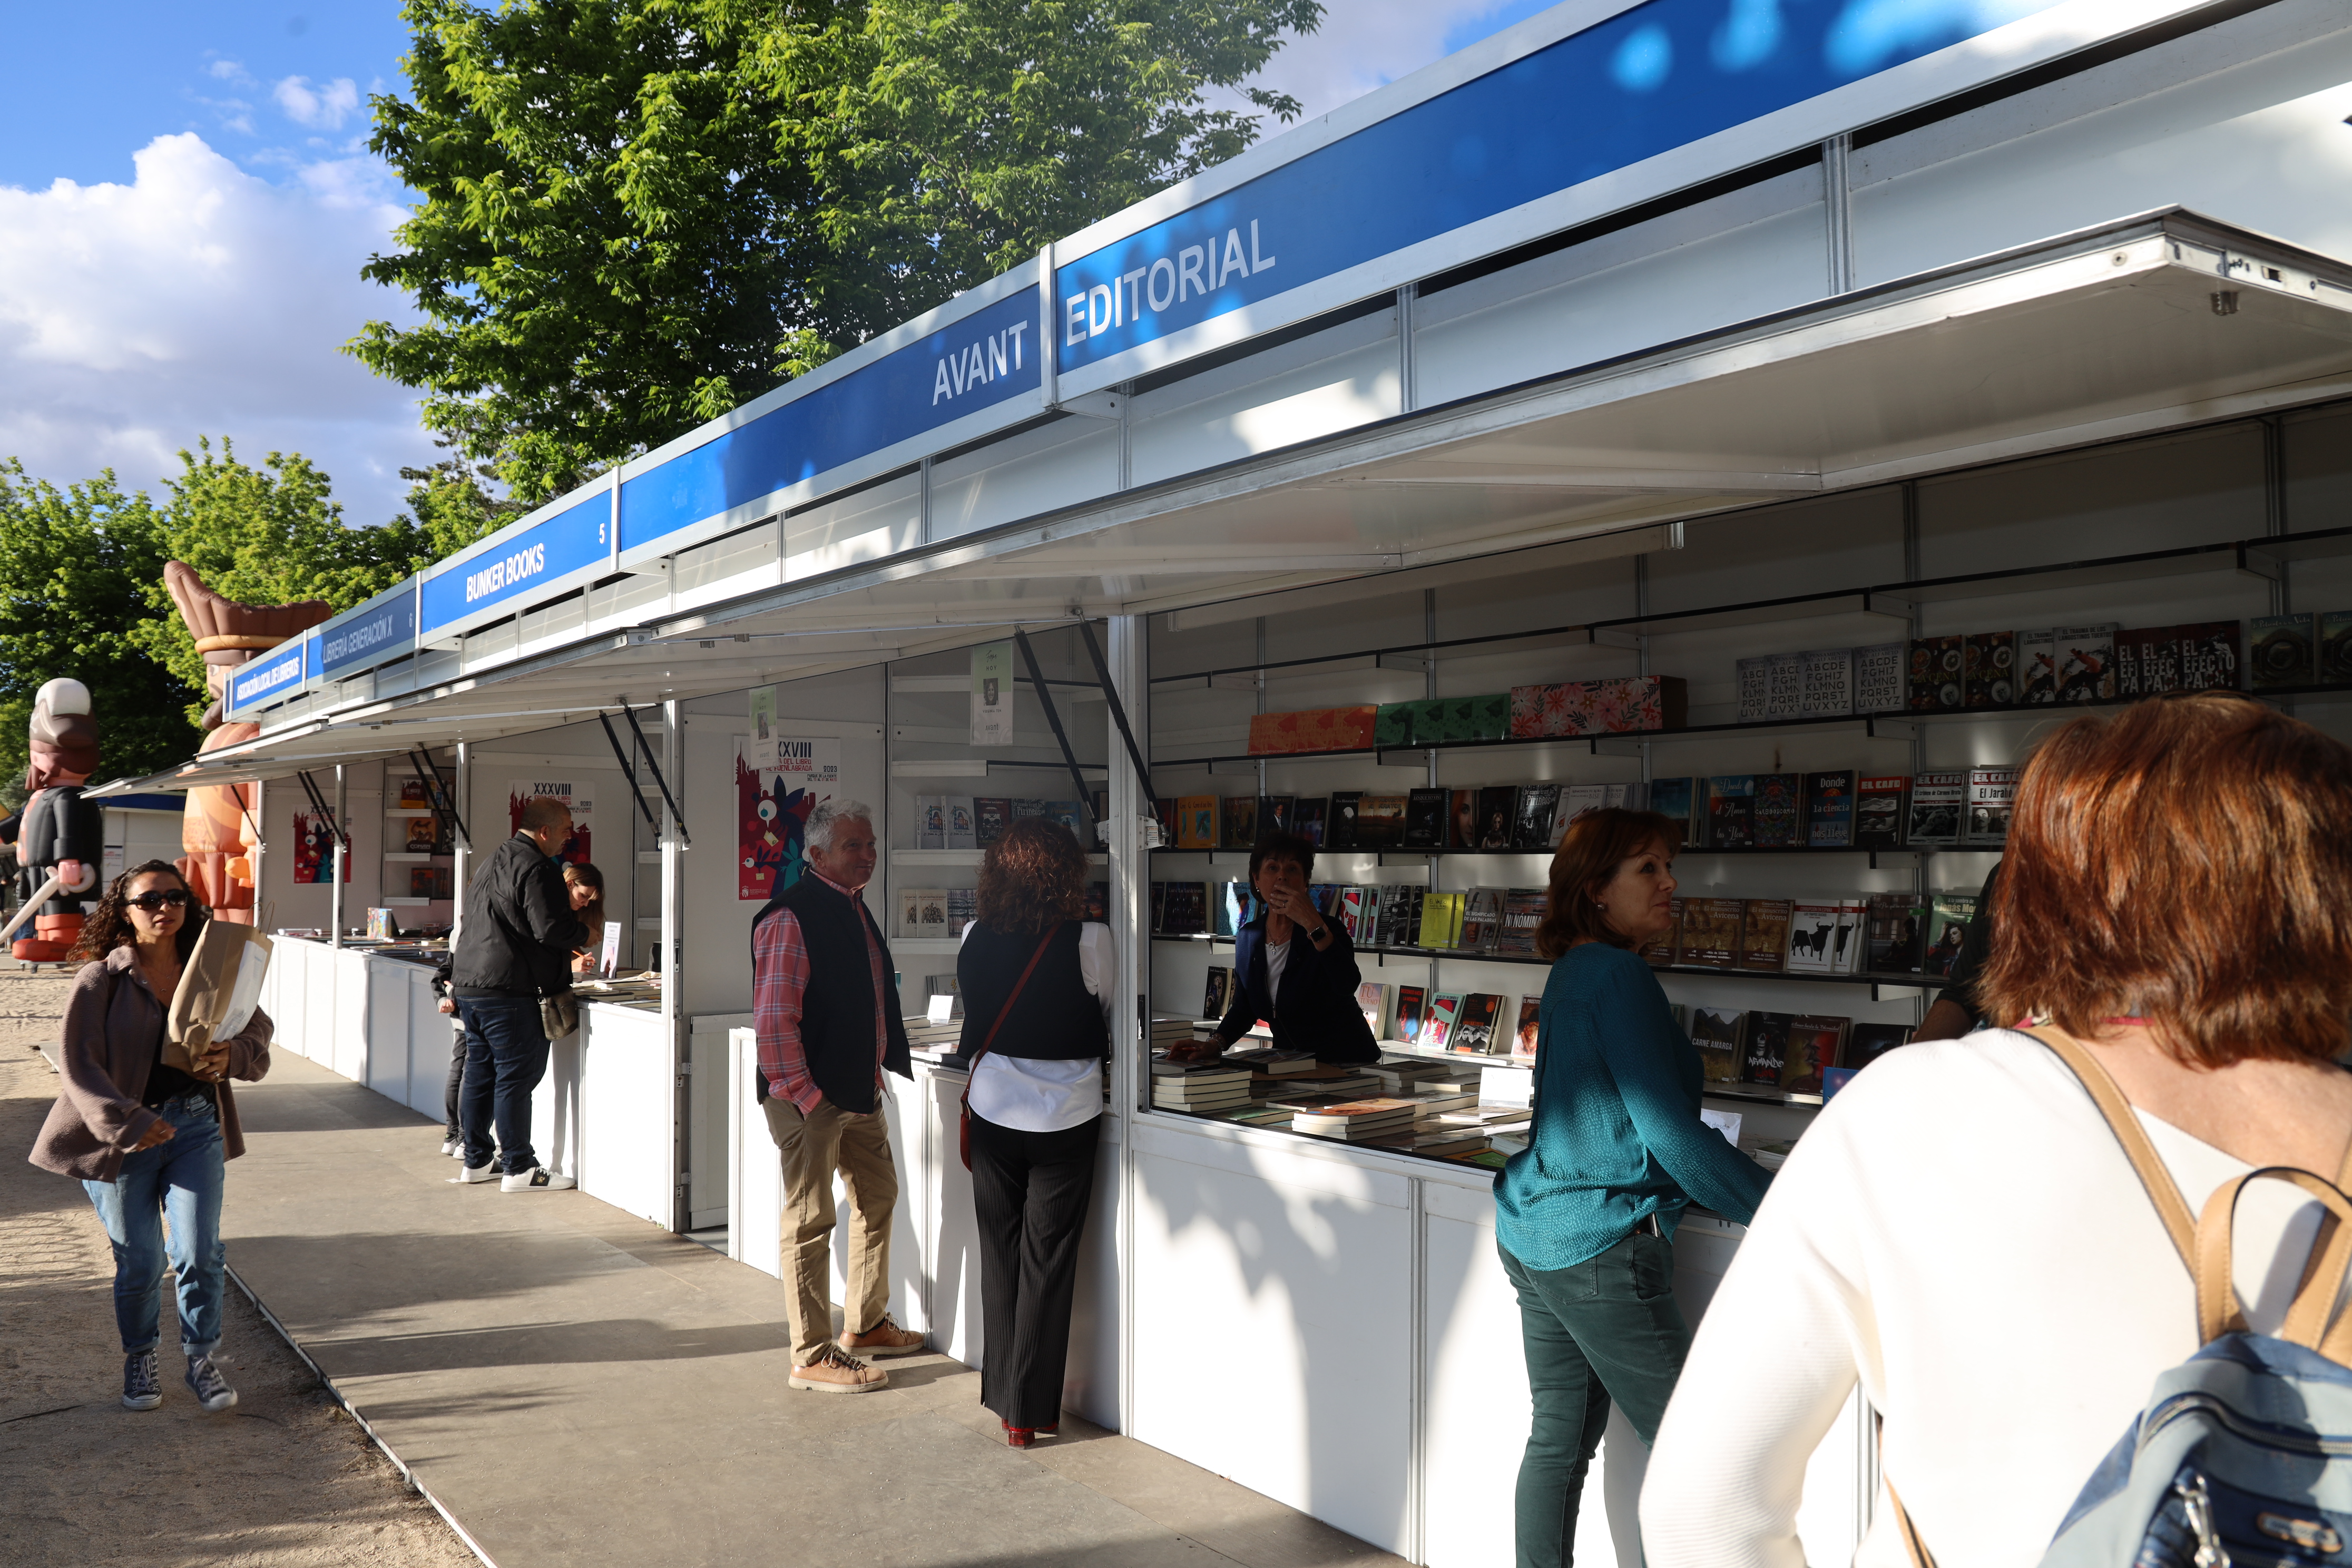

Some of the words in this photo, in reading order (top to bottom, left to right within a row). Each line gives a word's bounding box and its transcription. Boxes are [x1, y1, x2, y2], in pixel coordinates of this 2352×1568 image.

[1066, 219, 1276, 347] EDITORIAL
[933, 320, 1027, 406] AVANT
[599, 523, 605, 544] 5
[466, 561, 505, 602] BUNKER
[506, 543, 544, 585] BOOKS
[409, 612, 413, 628] 6
[2294, 615, 2311, 624] Vida
[323, 632, 348, 664] LIBRERÍA
[348, 614, 387, 654] GENERACIÓN
[387, 614, 393, 637] X
[1866, 645, 1901, 654] PENSAMIENTO
[2119, 644, 2134, 662] EL
[2142, 643, 2157, 660] EL
[2182, 639, 2198, 656] EL
[278, 656, 299, 683] LIBREROS
[2183, 654, 2235, 673] EFECTO
[1913, 672, 1929, 684] LA
[1930, 671, 1958, 682] CENA
[1978, 668, 2010, 680] CENA
[1820, 777, 1846, 788] Donde
[1916, 776, 1931, 785] EL
[1933, 775, 1962, 785] CASO
[1974, 773, 1989, 782] EL
[534, 782, 571, 796] XXXVIII
[1720, 778, 1743, 793] Donde
[1861, 781, 1874, 789] EL
[1876, 780, 1900, 789] CASO
[1979, 788, 1986, 798] El
[1526, 795, 1551, 806] Pirineos
[1016, 806, 1042, 816] Pirineos
[1716, 804, 1721, 815] el
[1724, 802, 1747, 817] Amor
[1823, 803, 1849, 812] ciencia
[1827, 829, 1847, 838] lleve
[1892, 831, 1897, 842] 1
[1939, 903, 1961, 913] Jonás
[1361, 986, 1374, 998] TU
[1692, 1037, 1710, 1048] CARNE
[1710, 1041, 1733, 1051] AMARGA
[1748, 1056, 1784, 1069] ARMANDO
[1712, 1121, 1730, 1131] desde
